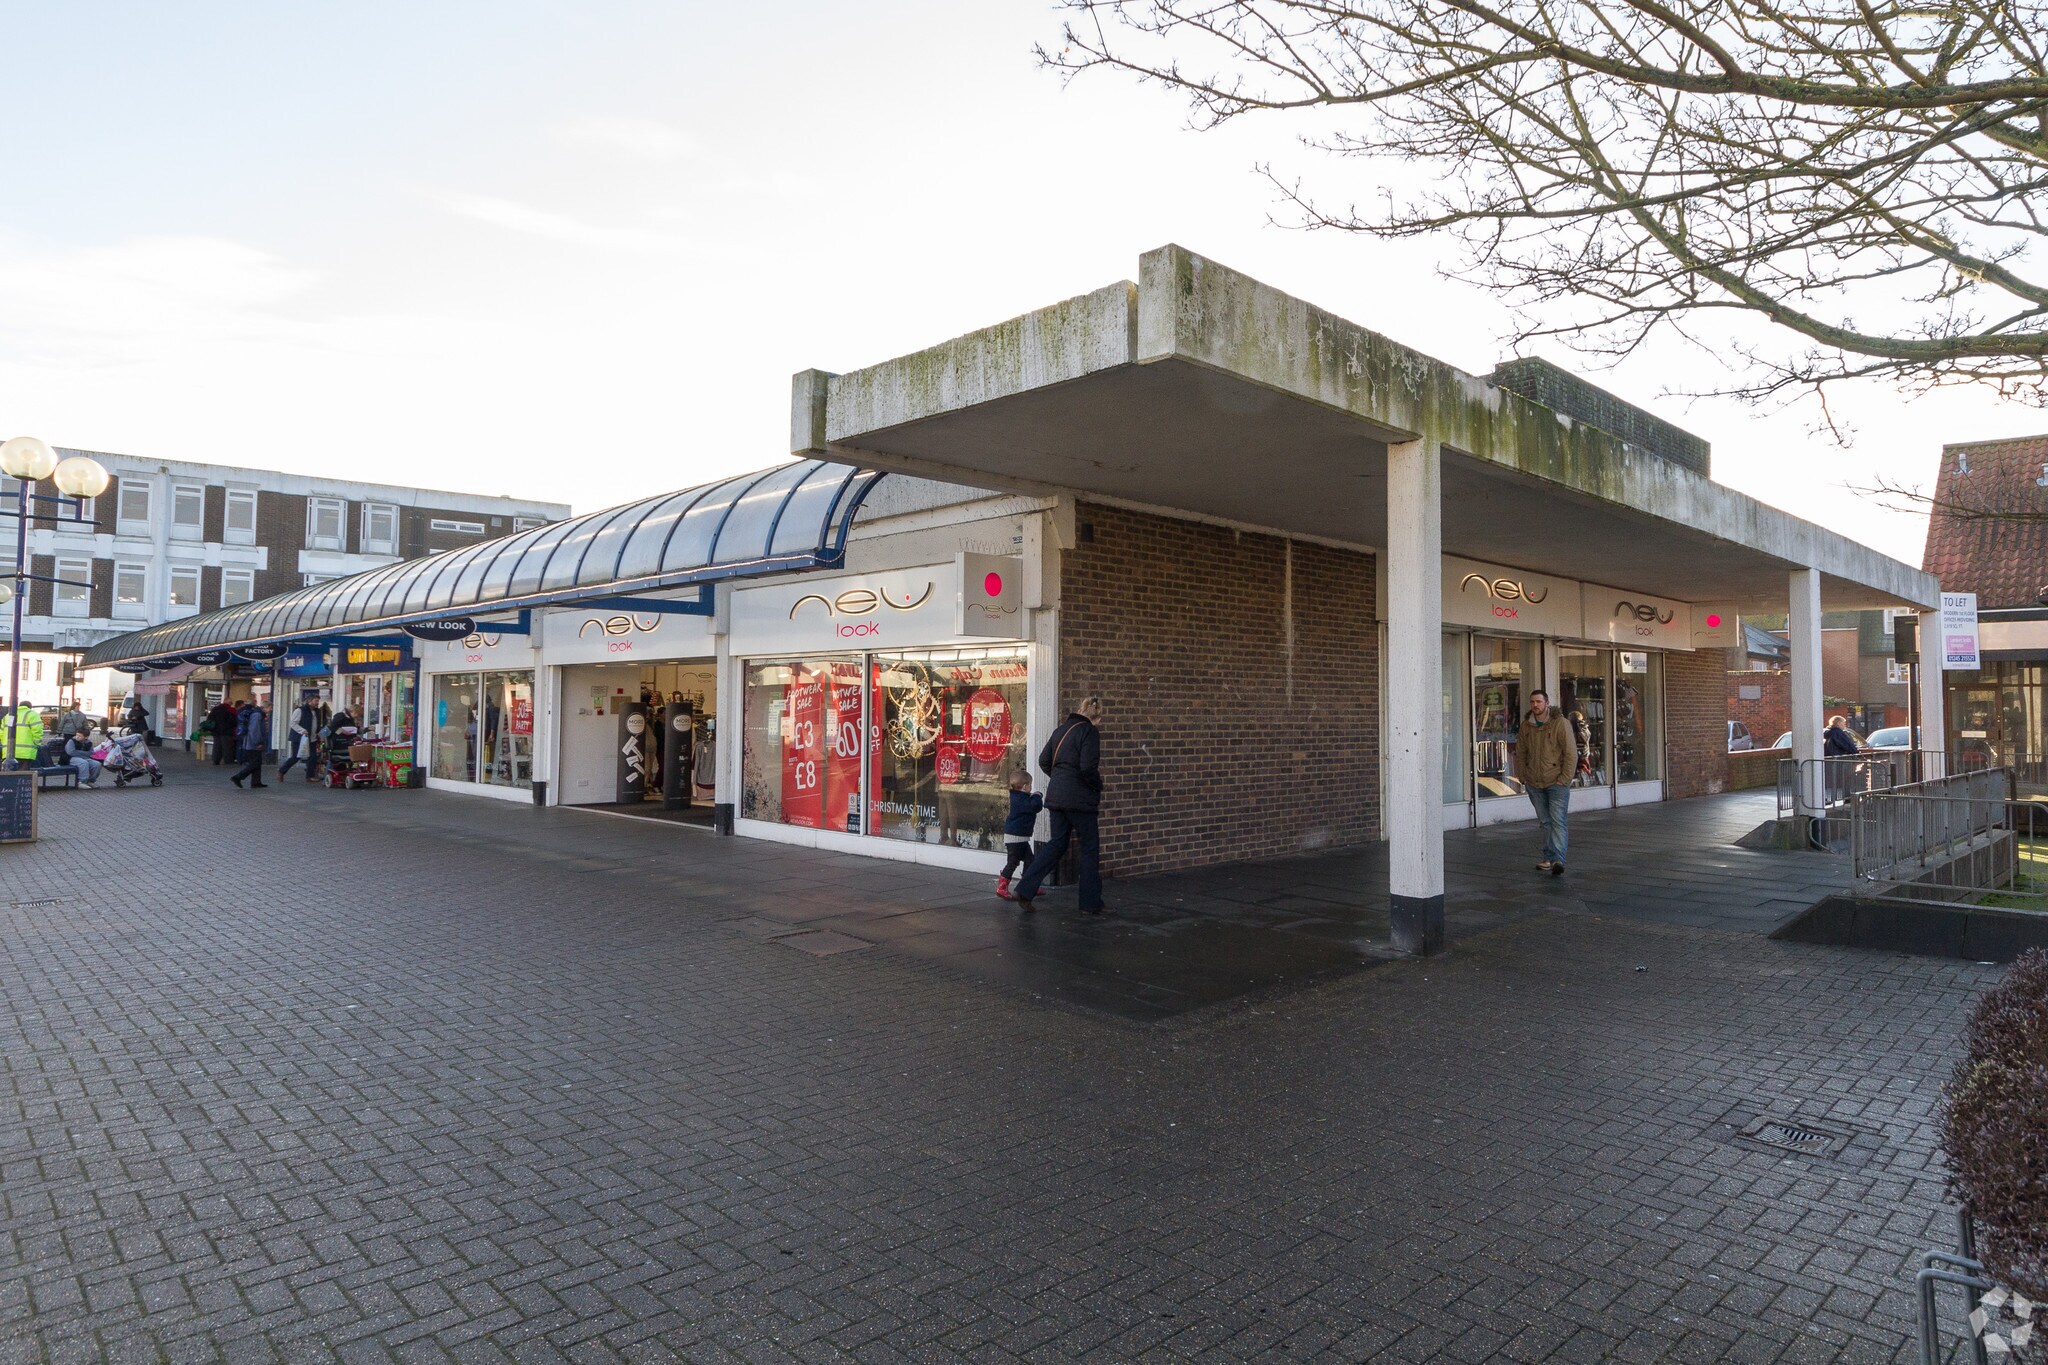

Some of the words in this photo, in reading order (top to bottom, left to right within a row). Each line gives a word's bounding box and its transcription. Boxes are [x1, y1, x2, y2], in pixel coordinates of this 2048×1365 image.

[1944, 598, 1954, 607] TO
[1956, 598, 1967, 607] LET
[1491, 604, 1519, 619] look
[438, 622, 466, 630] LOOK
[837, 621, 879, 637] look
[1635, 625, 1654, 637] look
[608, 639, 633, 652] look
[466, 653, 483, 662] look
[839, 701, 859, 711] SALE
[795, 720, 814, 750] £3
[971, 732, 1001, 745] PARTY
[795, 760, 817, 790] £8
[869, 800, 913, 815] CHRISTMAS
[915, 804, 936, 818] TIME
